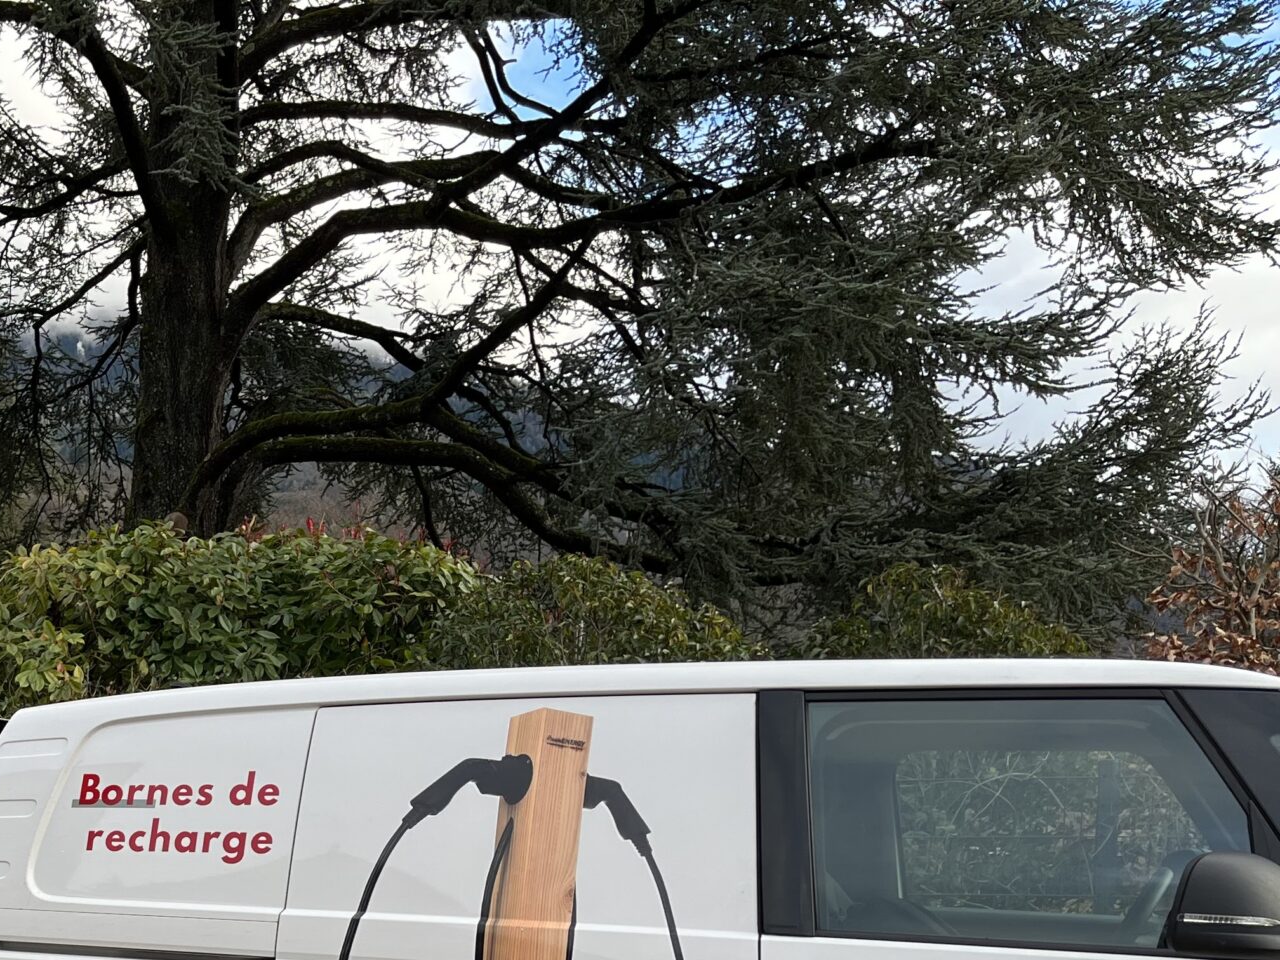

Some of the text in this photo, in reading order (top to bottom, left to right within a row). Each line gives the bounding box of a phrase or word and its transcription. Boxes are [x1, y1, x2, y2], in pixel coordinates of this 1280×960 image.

[78, 770, 280, 806] Bornes de
[86, 818, 273, 864] recharge
